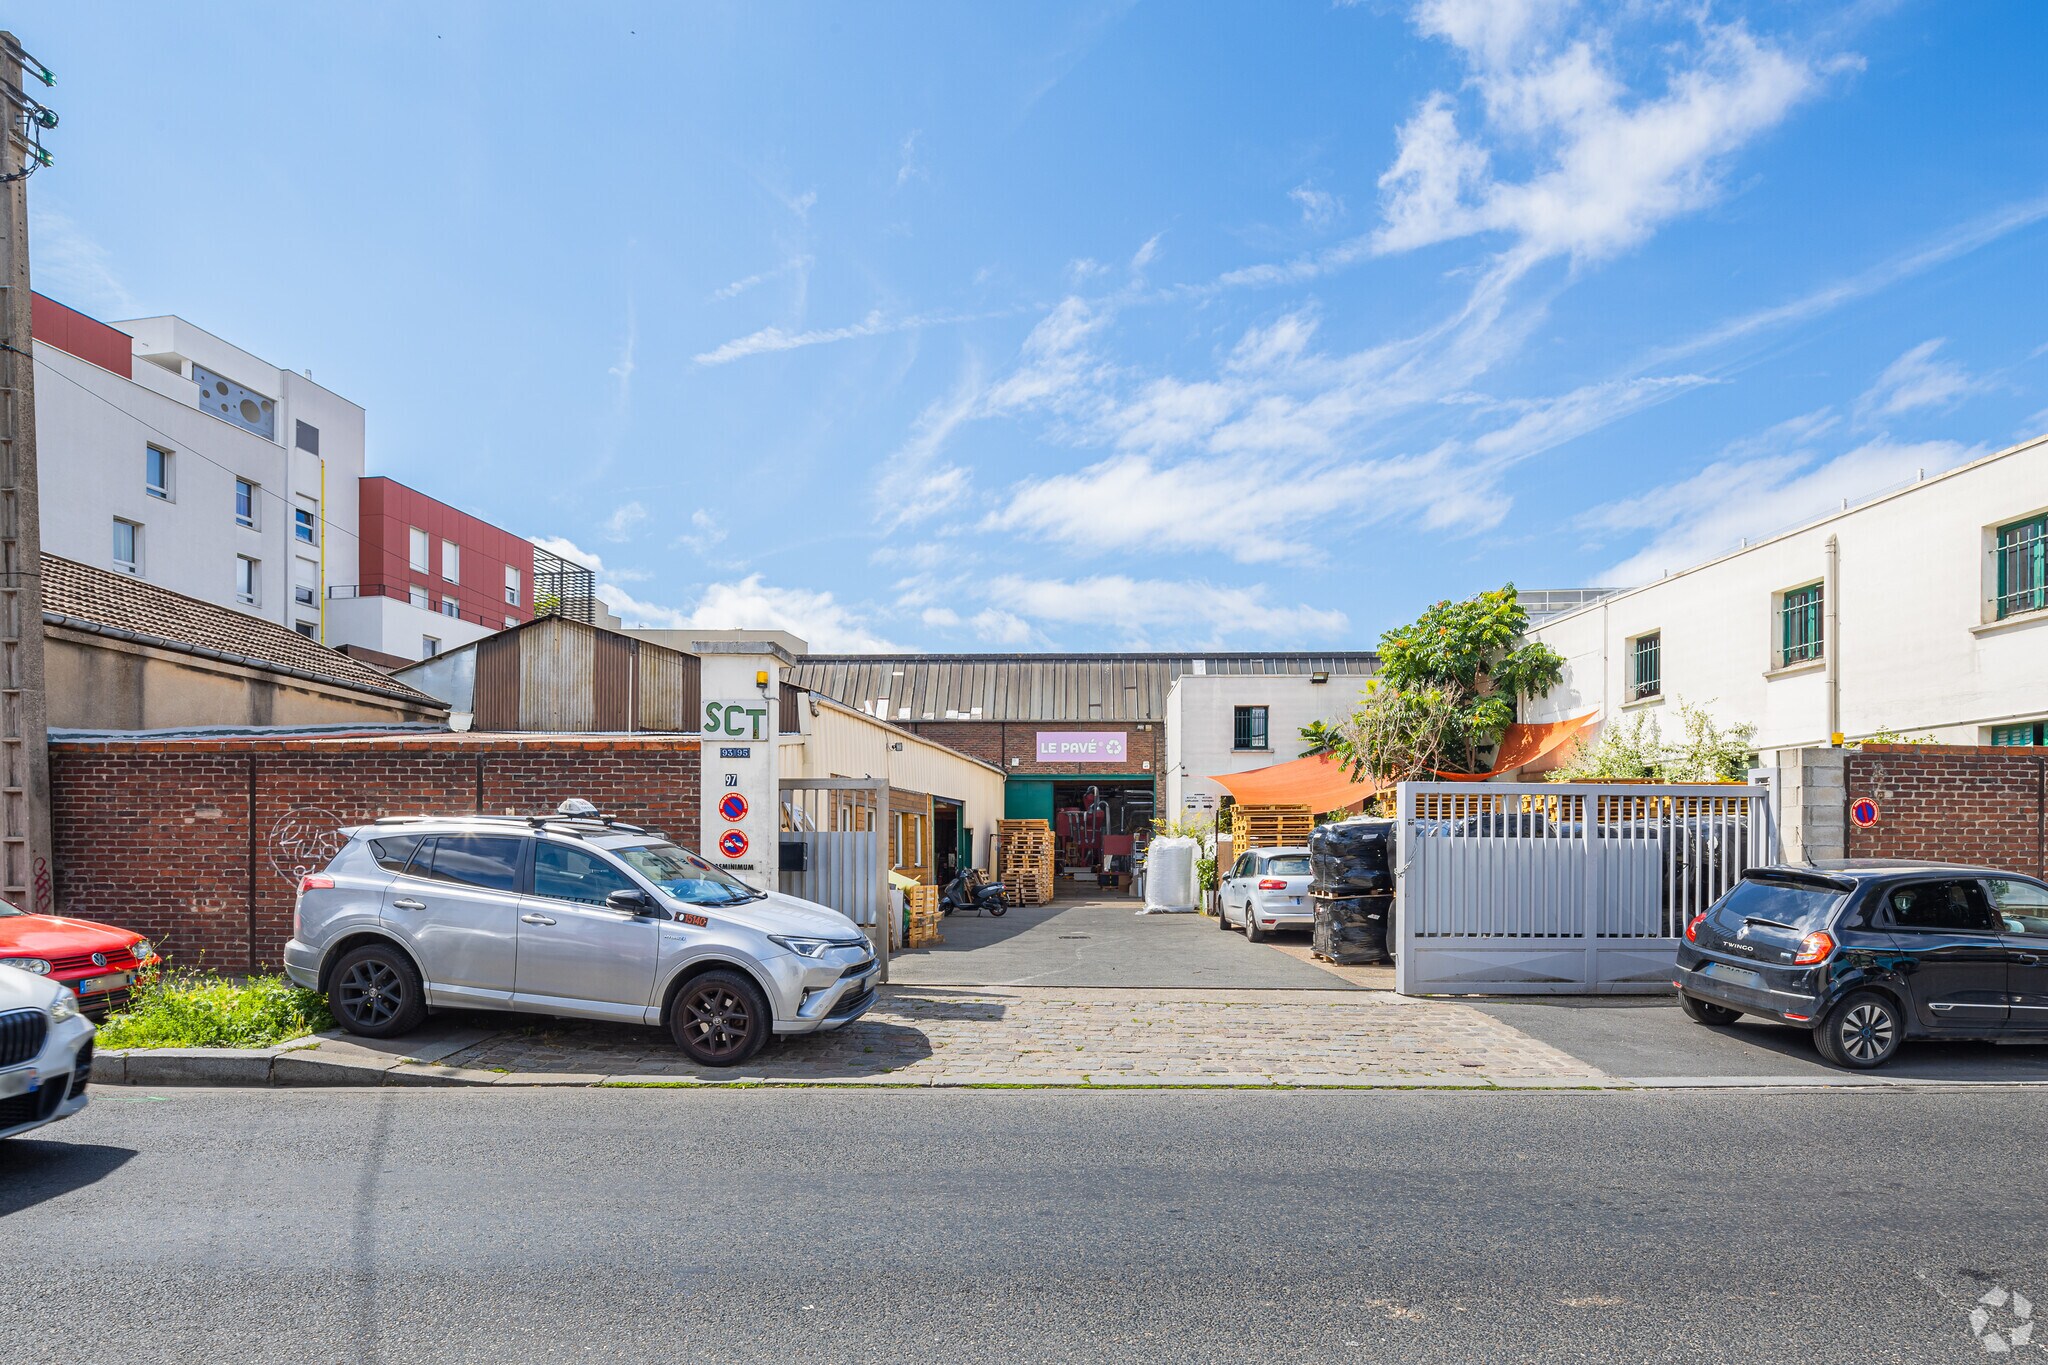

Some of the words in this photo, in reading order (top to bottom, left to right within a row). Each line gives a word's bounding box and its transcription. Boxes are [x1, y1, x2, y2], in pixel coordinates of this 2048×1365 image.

[703, 701, 767, 739] SCT
[1041, 742, 1057, 754] LE
[1060, 738, 1097, 754] PAVÉ
[722, 749, 733, 757] 93
[737, 749, 749, 757] 95
[725, 774, 736, 786] 97
[684, 913, 707, 926] 15140
[1723, 941, 1754, 951] TWINGO
